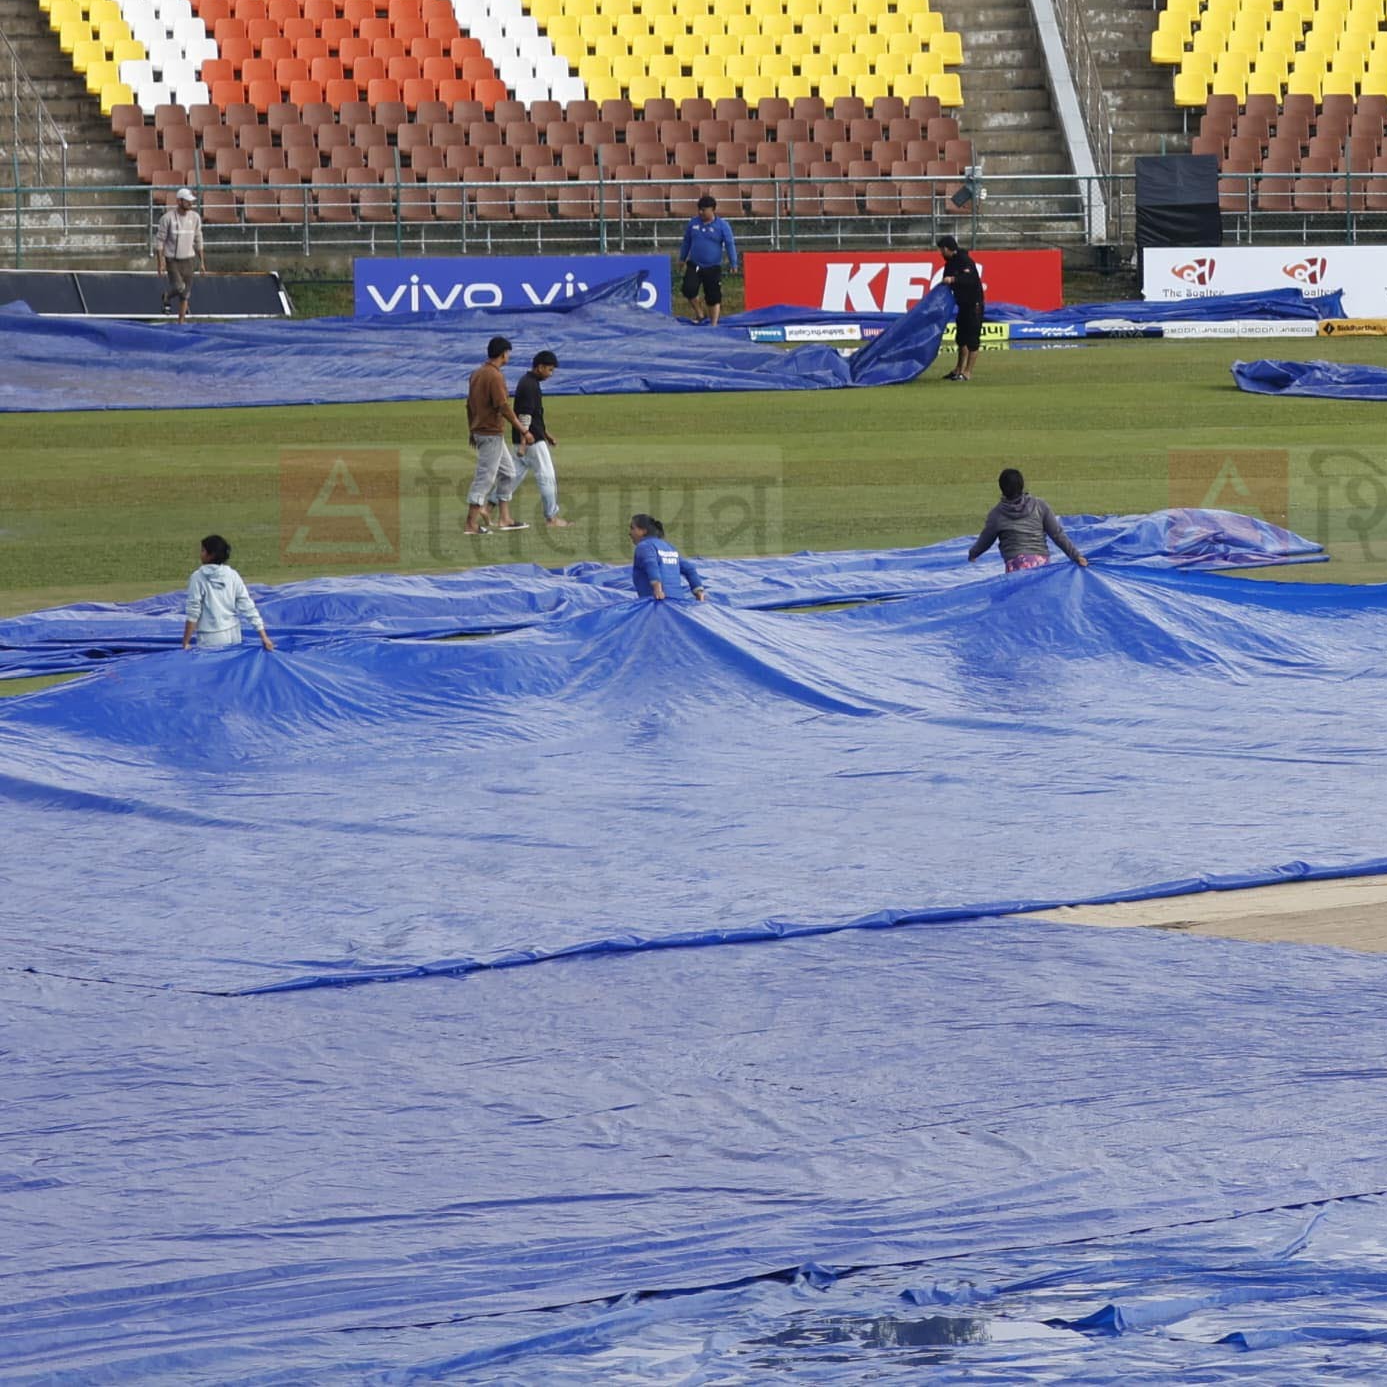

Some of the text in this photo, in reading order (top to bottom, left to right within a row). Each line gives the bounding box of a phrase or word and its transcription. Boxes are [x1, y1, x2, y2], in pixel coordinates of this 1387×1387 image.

[366, 274, 503, 311] vivo
[821, 262, 983, 312] KF
[1162, 288, 1182, 297] The
